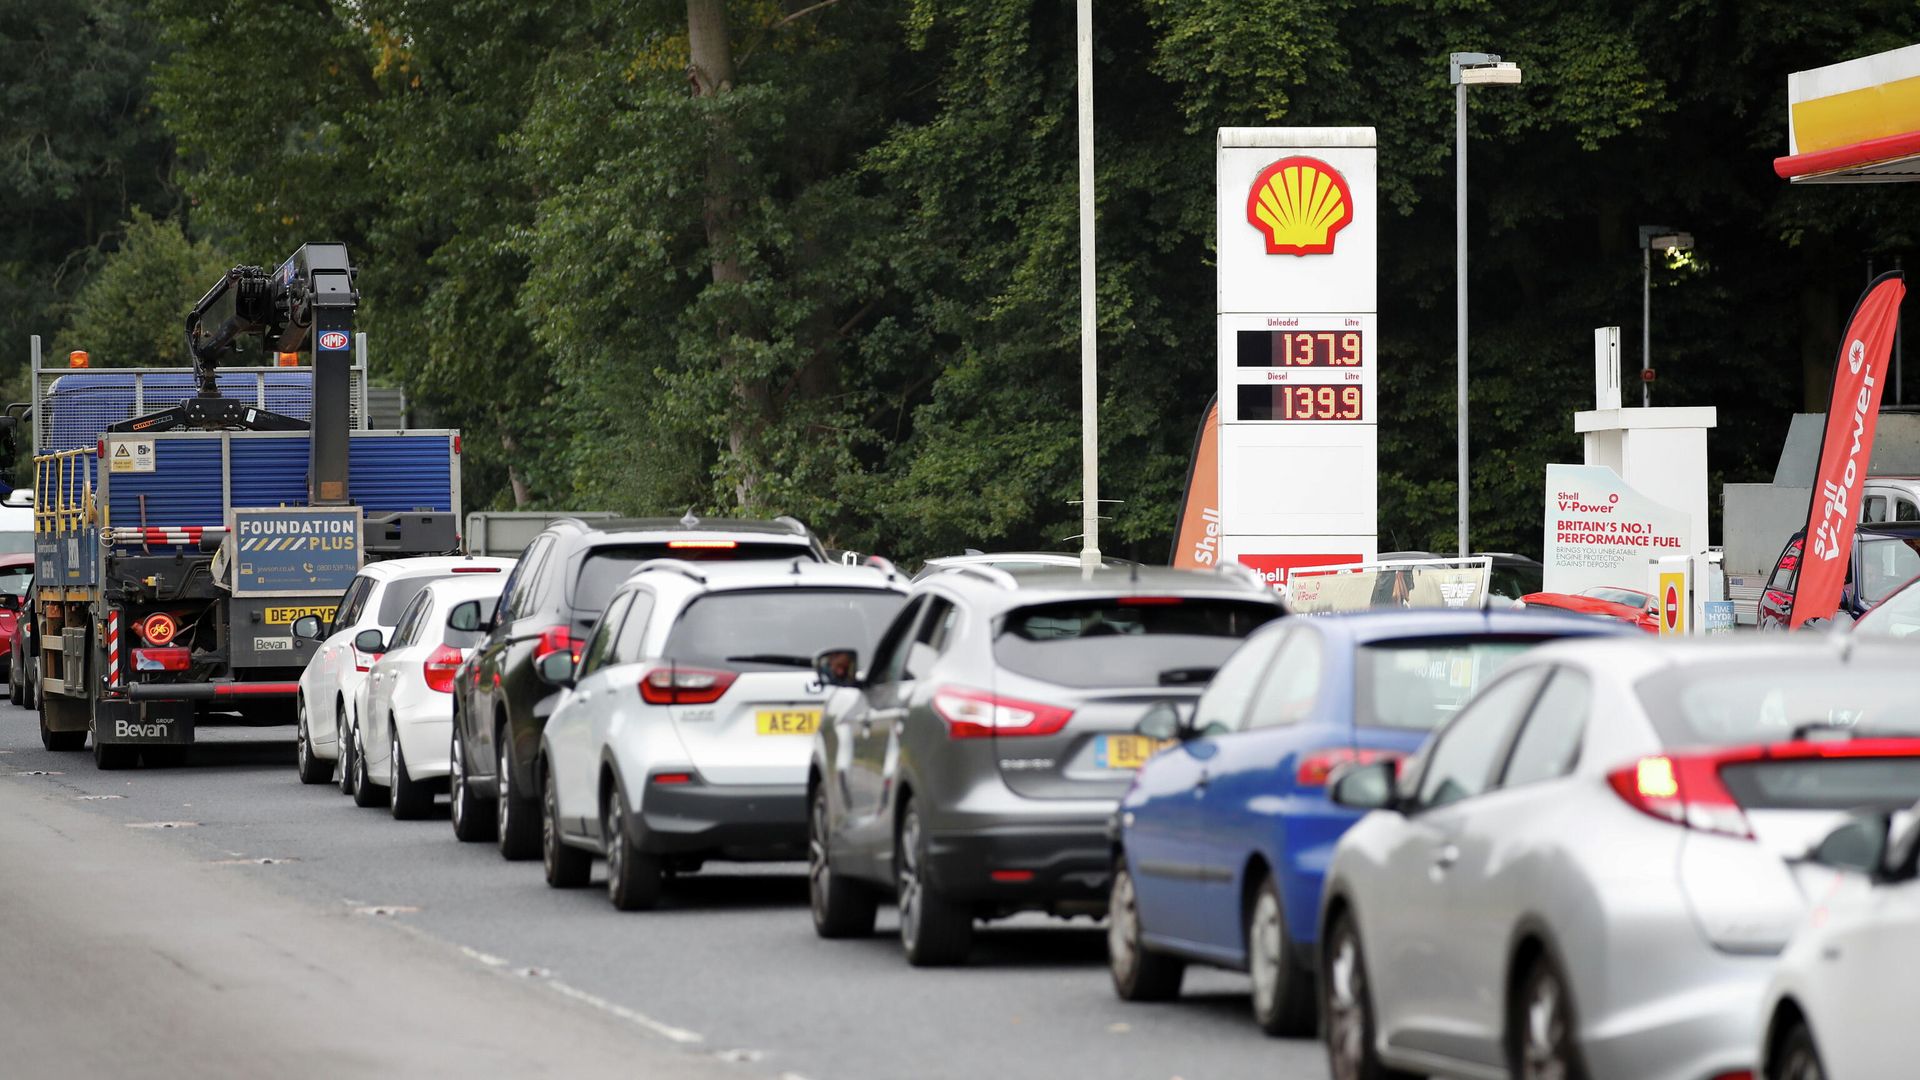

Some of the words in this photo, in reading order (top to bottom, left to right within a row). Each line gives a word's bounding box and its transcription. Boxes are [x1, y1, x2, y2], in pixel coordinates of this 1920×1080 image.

[1267, 318, 1299, 327] Unleaded
[1344, 318, 1360, 327] Litre
[323, 334, 345, 347] HMF
[1283, 333, 1361, 366] 137.9
[1267, 371, 1288, 381] Diesel
[1344, 372, 1360, 381] Litre
[1283, 386, 1361, 420] 139.9
[1823, 363, 1875, 562] V-Power
[1557, 491, 1579, 501] Shell
[1557, 501, 1614, 514] V-Power
[1814, 478, 1838, 560] Shell
[240, 520, 354, 535] FOUNDATION
[1557, 520, 1617, 533] BRITAIN'S
[1620, 523, 1652, 534] NO.1
[309, 536, 355, 551] PLUS
[1194, 507, 1219, 566] Shell
[1556, 533, 1649, 547] PERFORMANCE
[1653, 536, 1681, 548] FUEL
[1556, 546, 1581, 554] BRINGS
[1583, 547, 1597, 555] YOU
[1599, 548, 1637, 556] UNBEATABLE
[1556, 553, 1581, 561] ENGINE
[1583, 554, 1625, 562] PROTECTION
[1555, 560, 1586, 568] AGAINST
[271, 608, 307, 622] DE20
[1713, 605, 1730, 613] TIME
[256, 639, 288, 650] Bevan
[115, 719, 168, 737] Bevan
[768, 712, 815, 732] AE21
